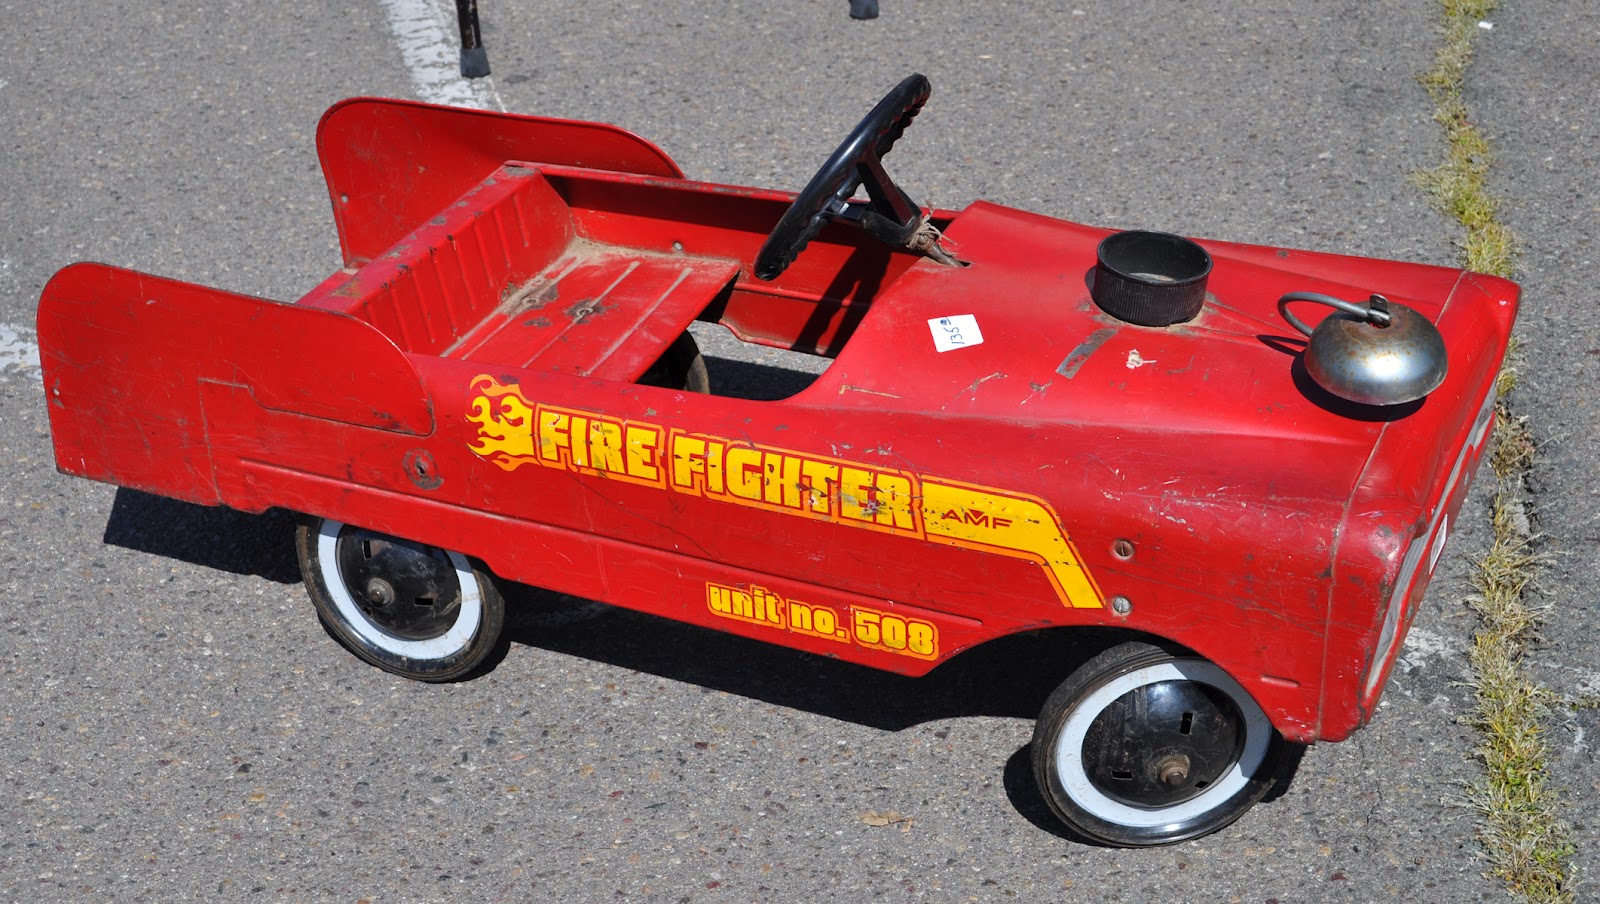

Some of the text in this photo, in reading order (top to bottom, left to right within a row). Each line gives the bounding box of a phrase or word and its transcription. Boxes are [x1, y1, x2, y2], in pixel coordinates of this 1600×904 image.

[538, 409, 914, 530] FIRE FIGHTER
[941, 508, 1013, 530] AMF
[709, 585, 935, 656] unit no. 508
